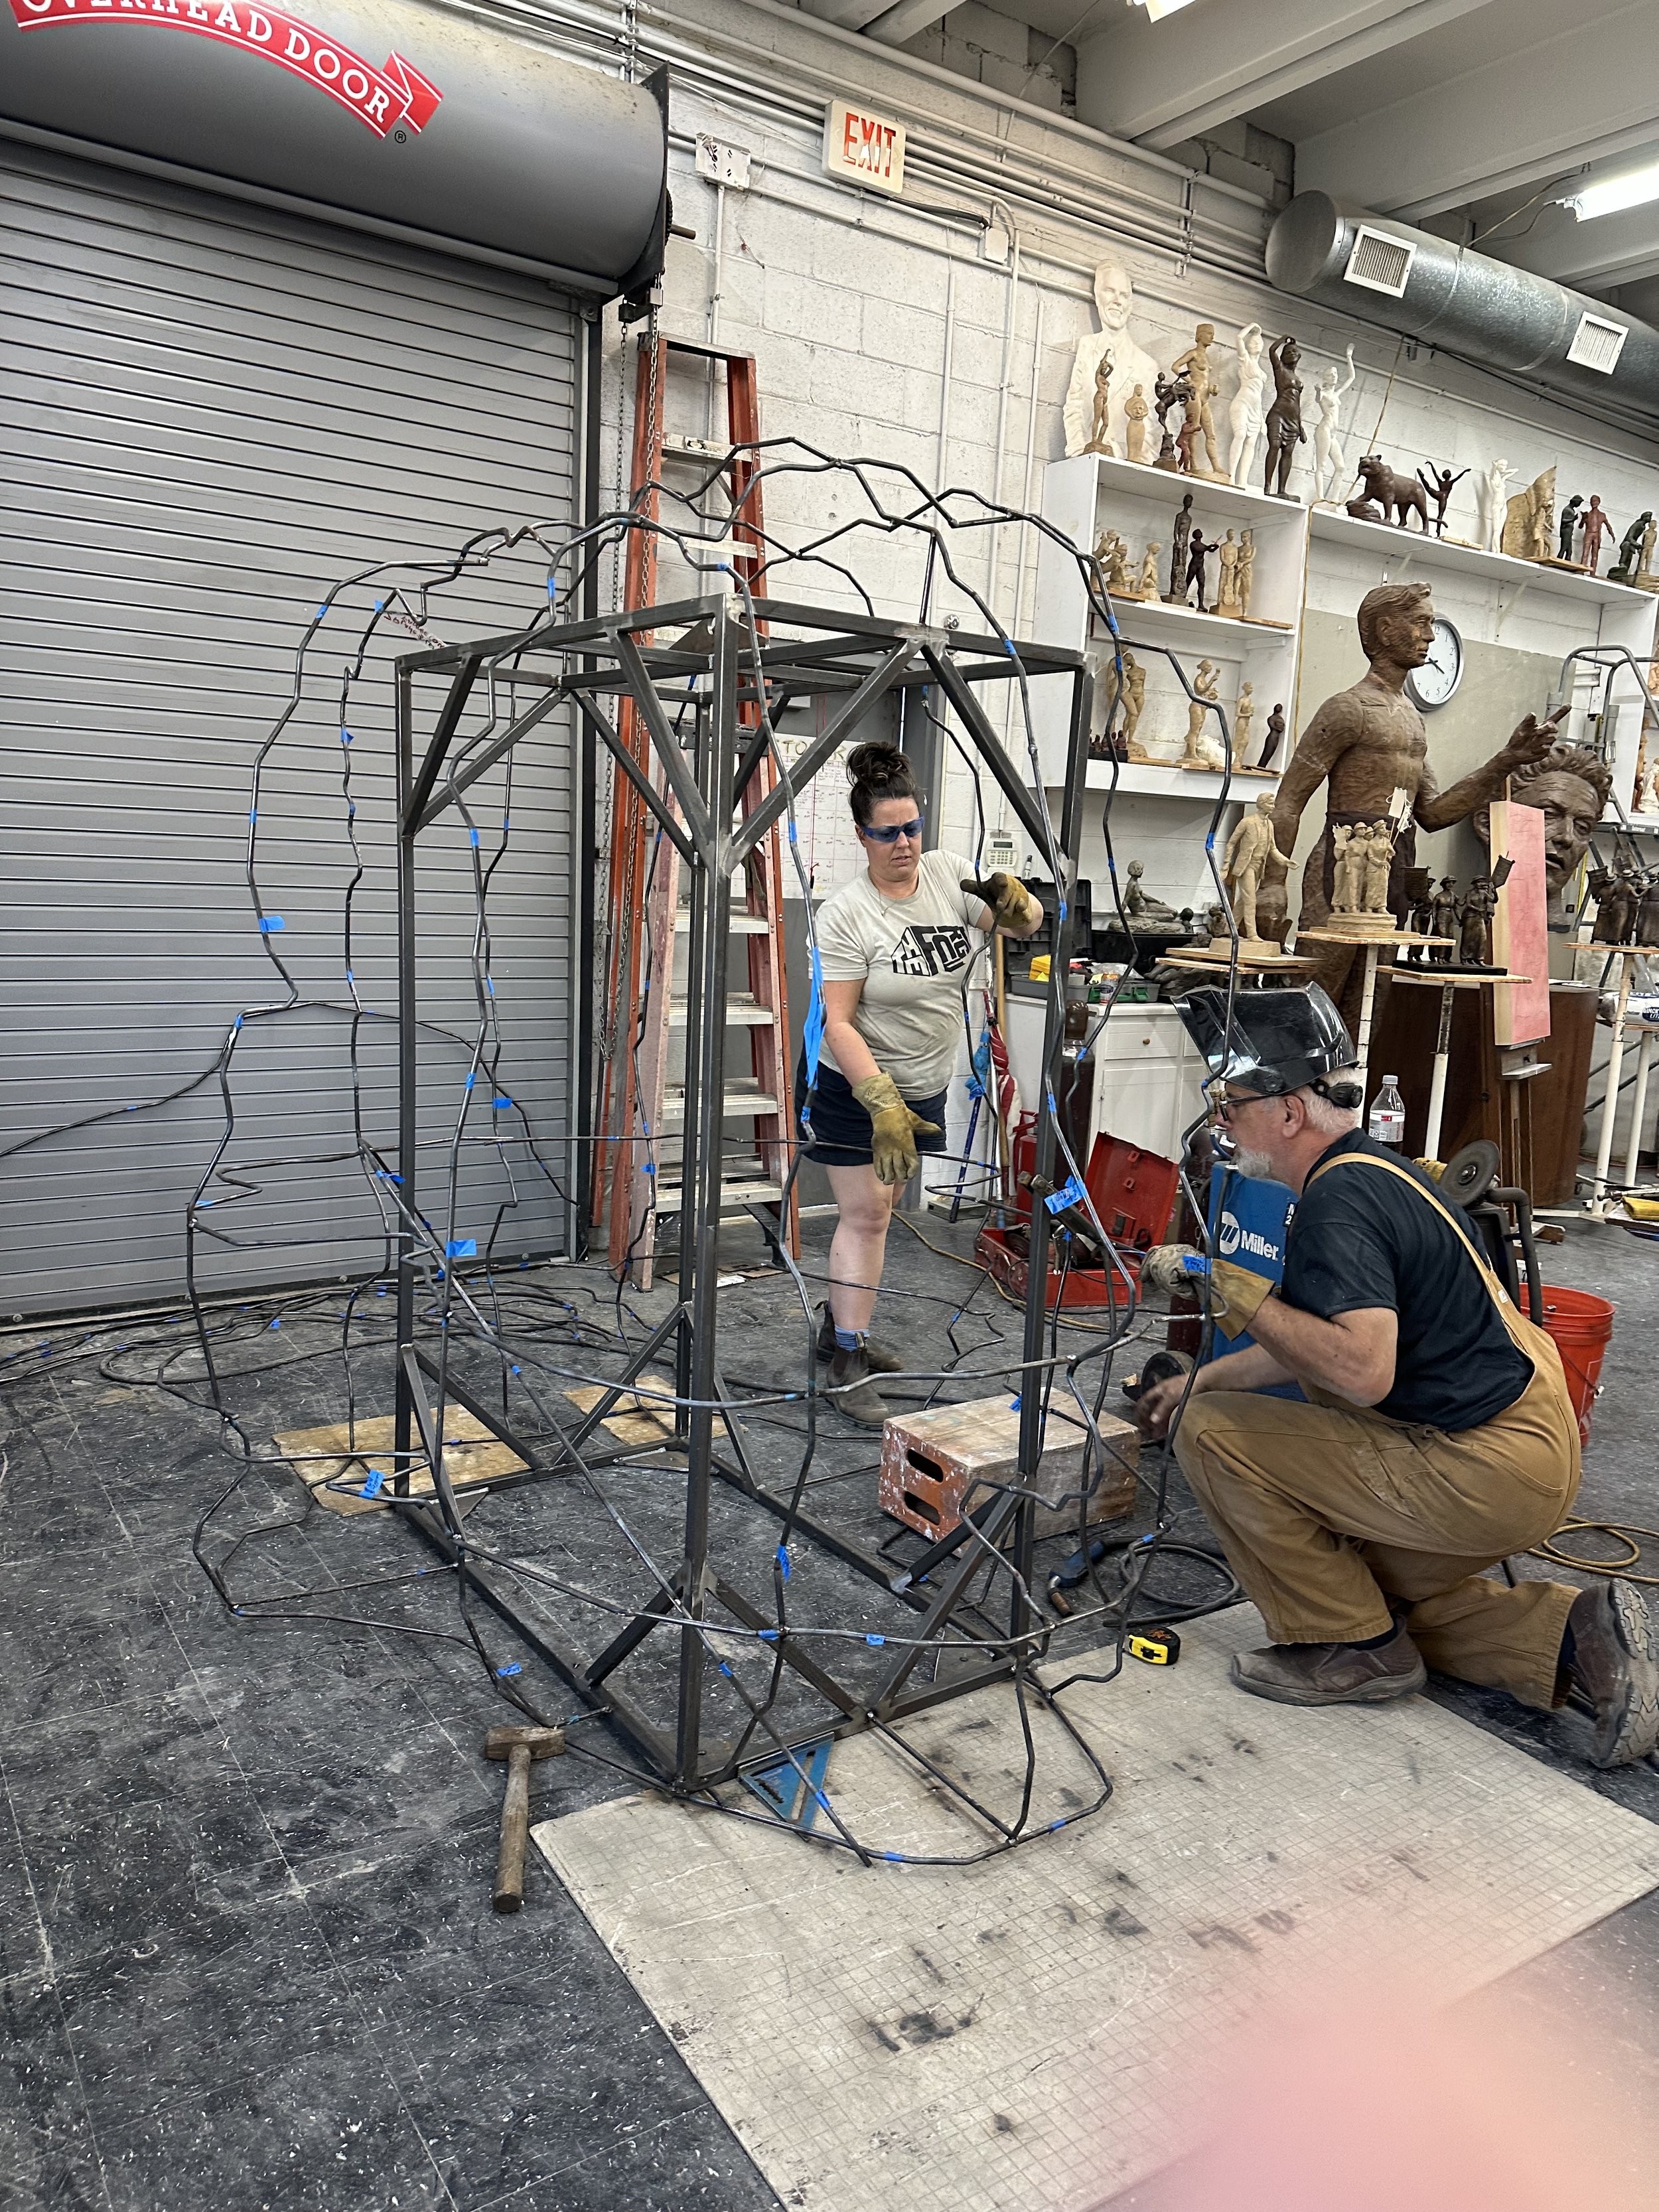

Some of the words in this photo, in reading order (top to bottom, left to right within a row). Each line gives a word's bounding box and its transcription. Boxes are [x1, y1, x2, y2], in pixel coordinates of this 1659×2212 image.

[284, 28, 390, 123] DOOR
[843, 111, 897, 178] EXIT
[1449, 647, 1454, 656] 2
[1436, 687, 1441, 696] 5
[1241, 1230, 1279, 1260] Miller
